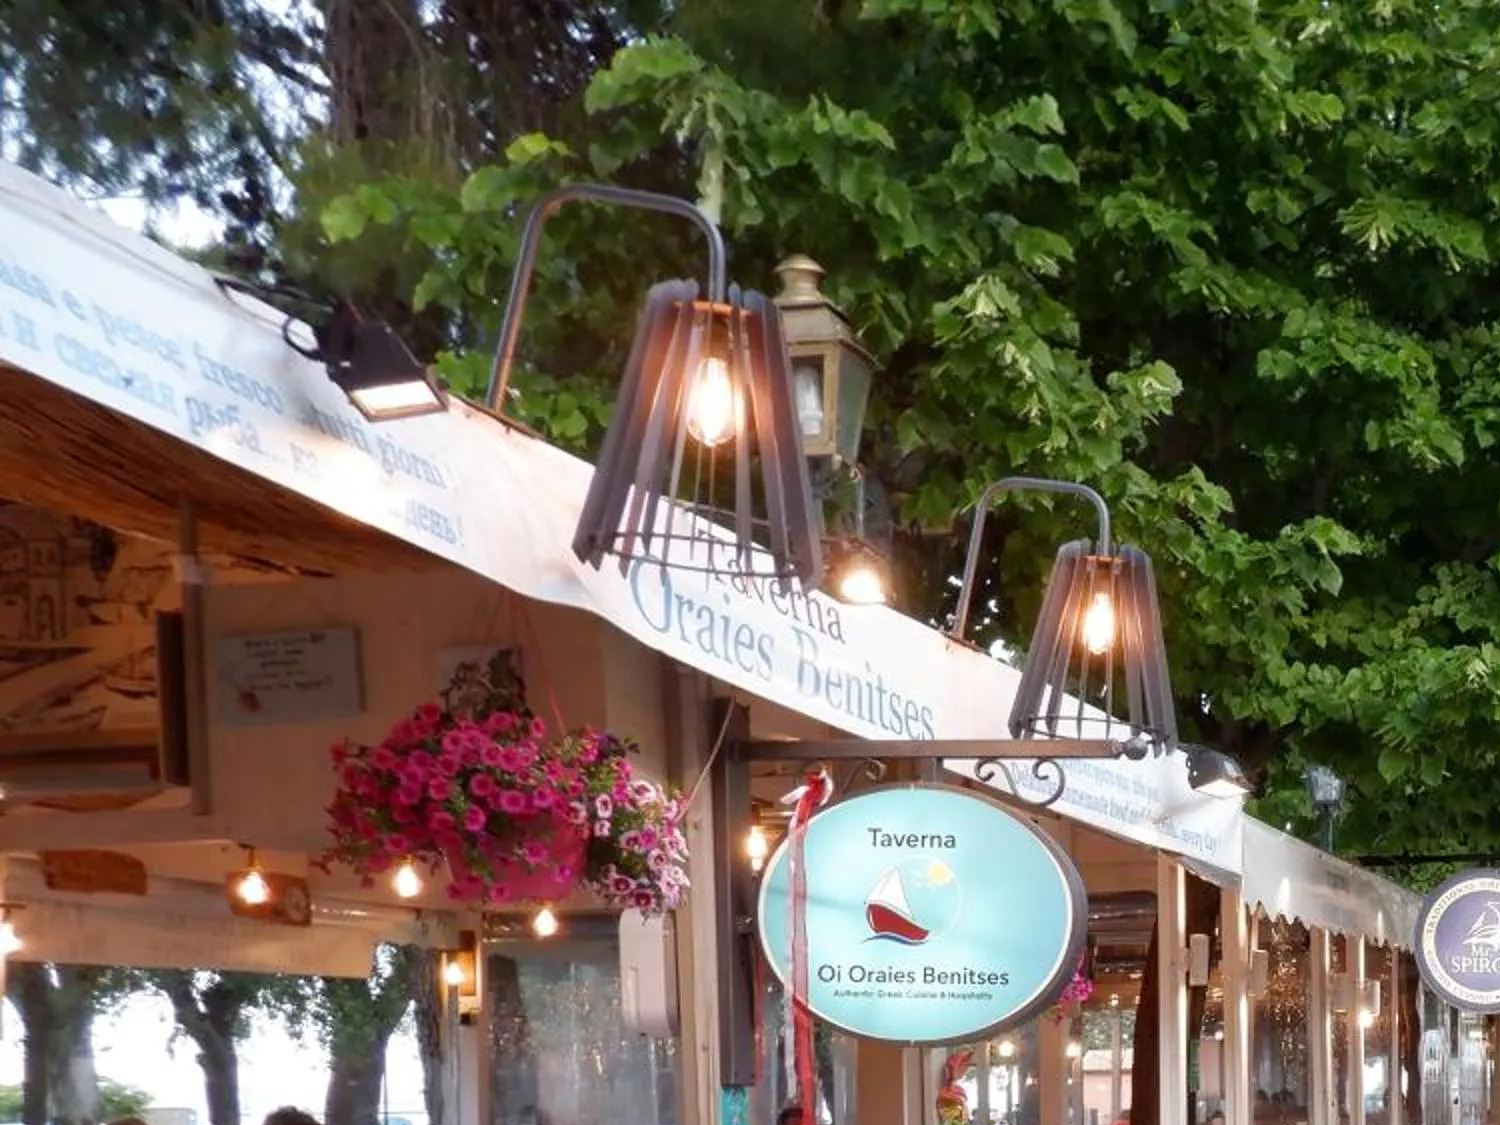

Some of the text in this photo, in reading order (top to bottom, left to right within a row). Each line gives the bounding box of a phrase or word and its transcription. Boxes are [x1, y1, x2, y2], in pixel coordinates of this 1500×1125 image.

[698, 528, 847, 645] Taverna
[630, 554, 936, 741] Oraies Benitses
[867, 827, 957, 849] Taverna
[817, 964, 1010, 986] Oi Oraies Benitses
